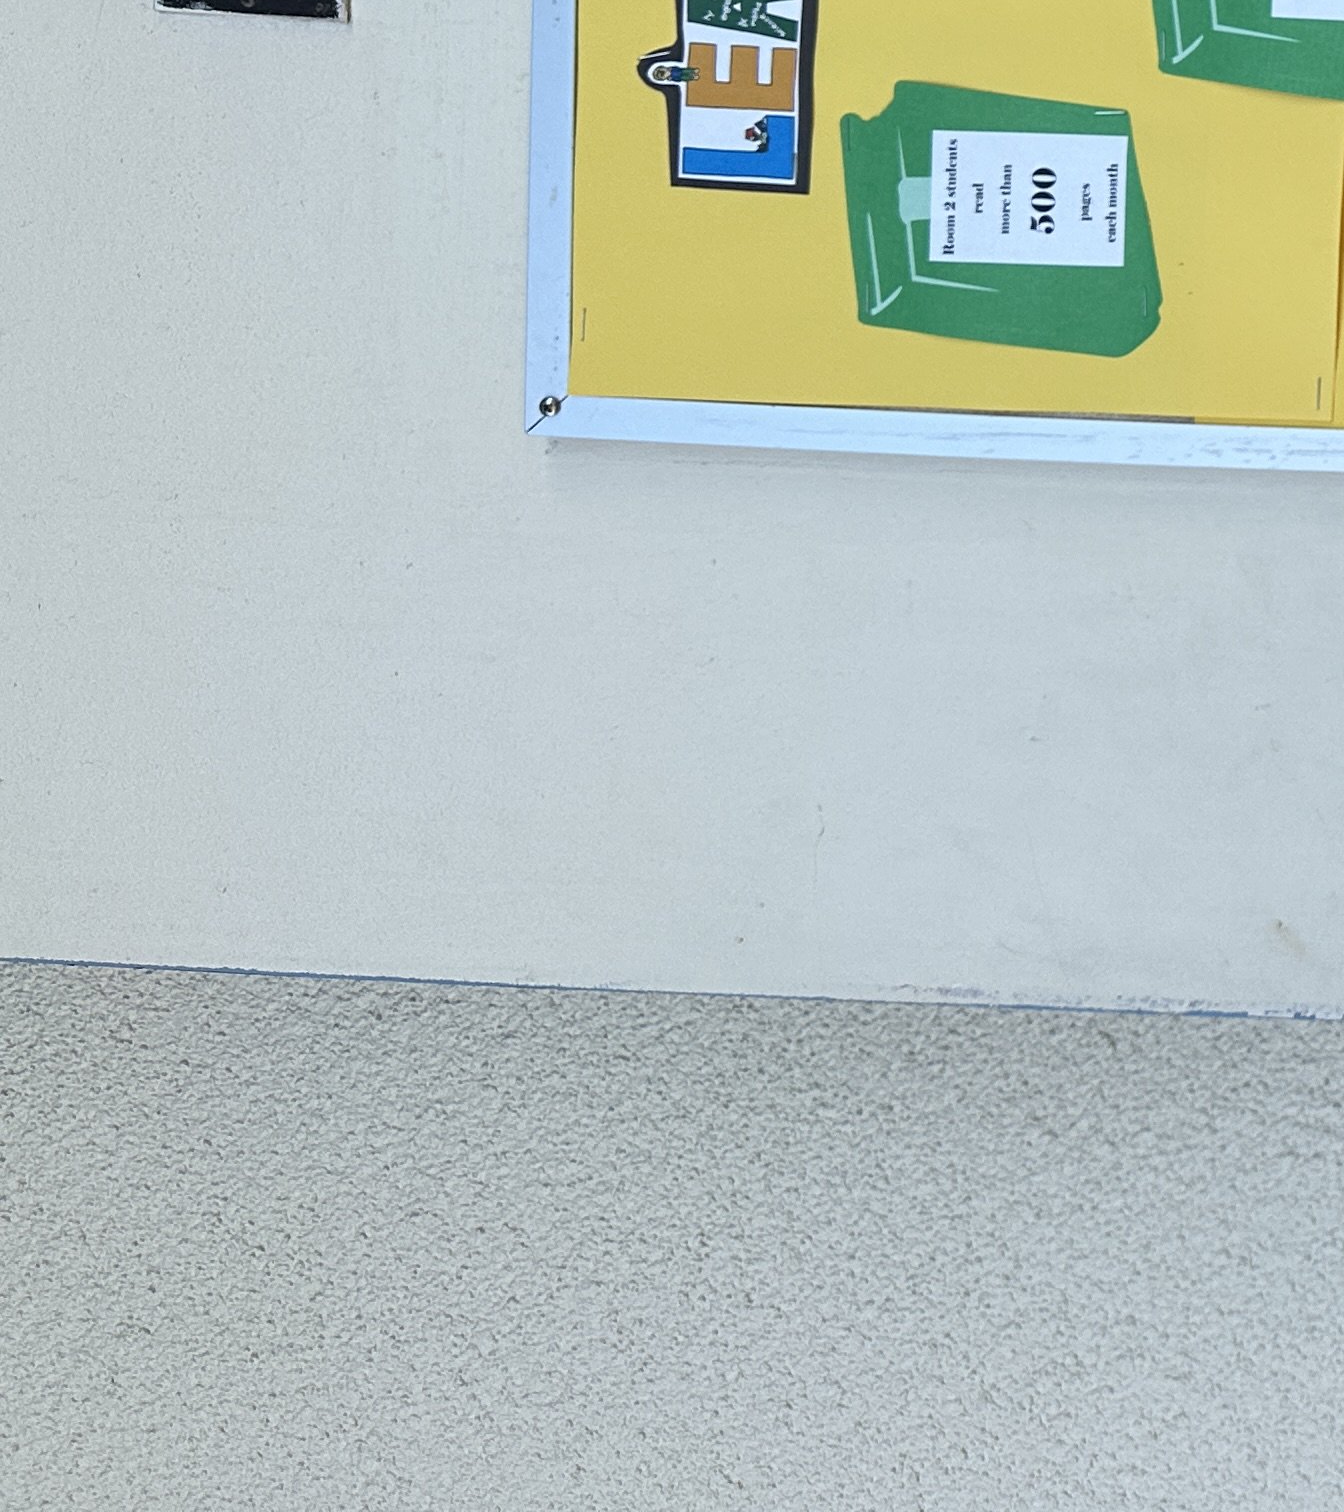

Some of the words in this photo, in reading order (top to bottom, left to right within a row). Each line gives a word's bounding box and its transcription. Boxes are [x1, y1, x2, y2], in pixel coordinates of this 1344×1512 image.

[945, 138, 958, 198] students
[999, 164, 1013, 196] than
[1106, 163, 1119, 208] month
[943, 201, 956, 211] 2
[971, 183, 984, 214] read
[1001, 198, 1011, 235] more
[1029, 167, 1057, 235] 500
[1081, 183, 1093, 222] pages
[942, 214, 956, 255] Room
[1104, 211, 1117, 243] each
